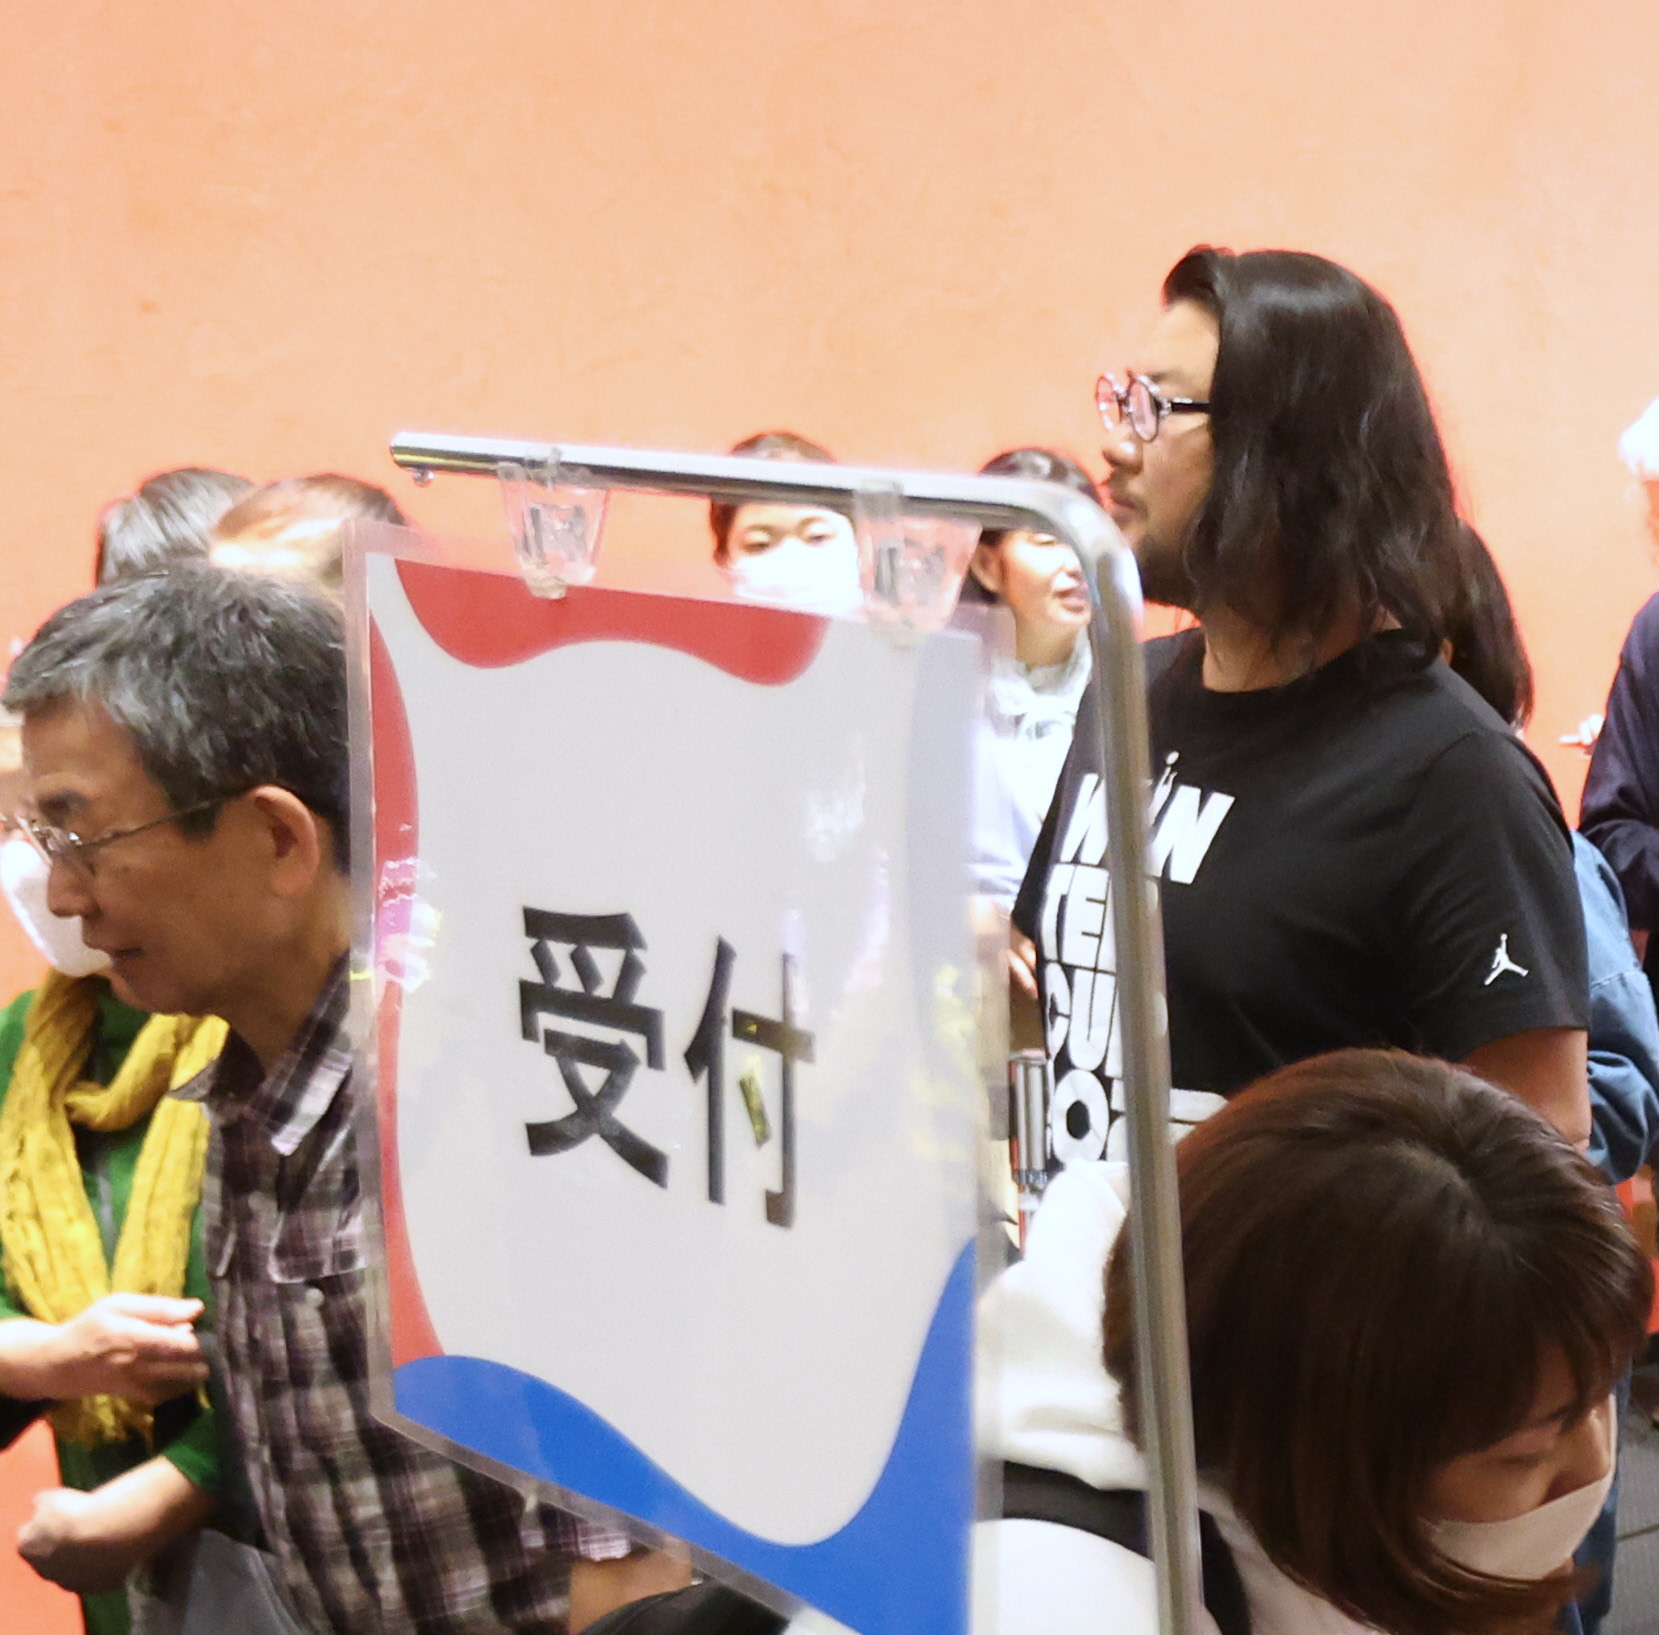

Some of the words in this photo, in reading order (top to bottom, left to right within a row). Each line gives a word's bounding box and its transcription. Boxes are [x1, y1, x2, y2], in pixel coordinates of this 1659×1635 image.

[1041, 863, 1160, 975] TE
[518, 905, 817, 1228] 受付
[1044, 961, 1168, 1080] CU
